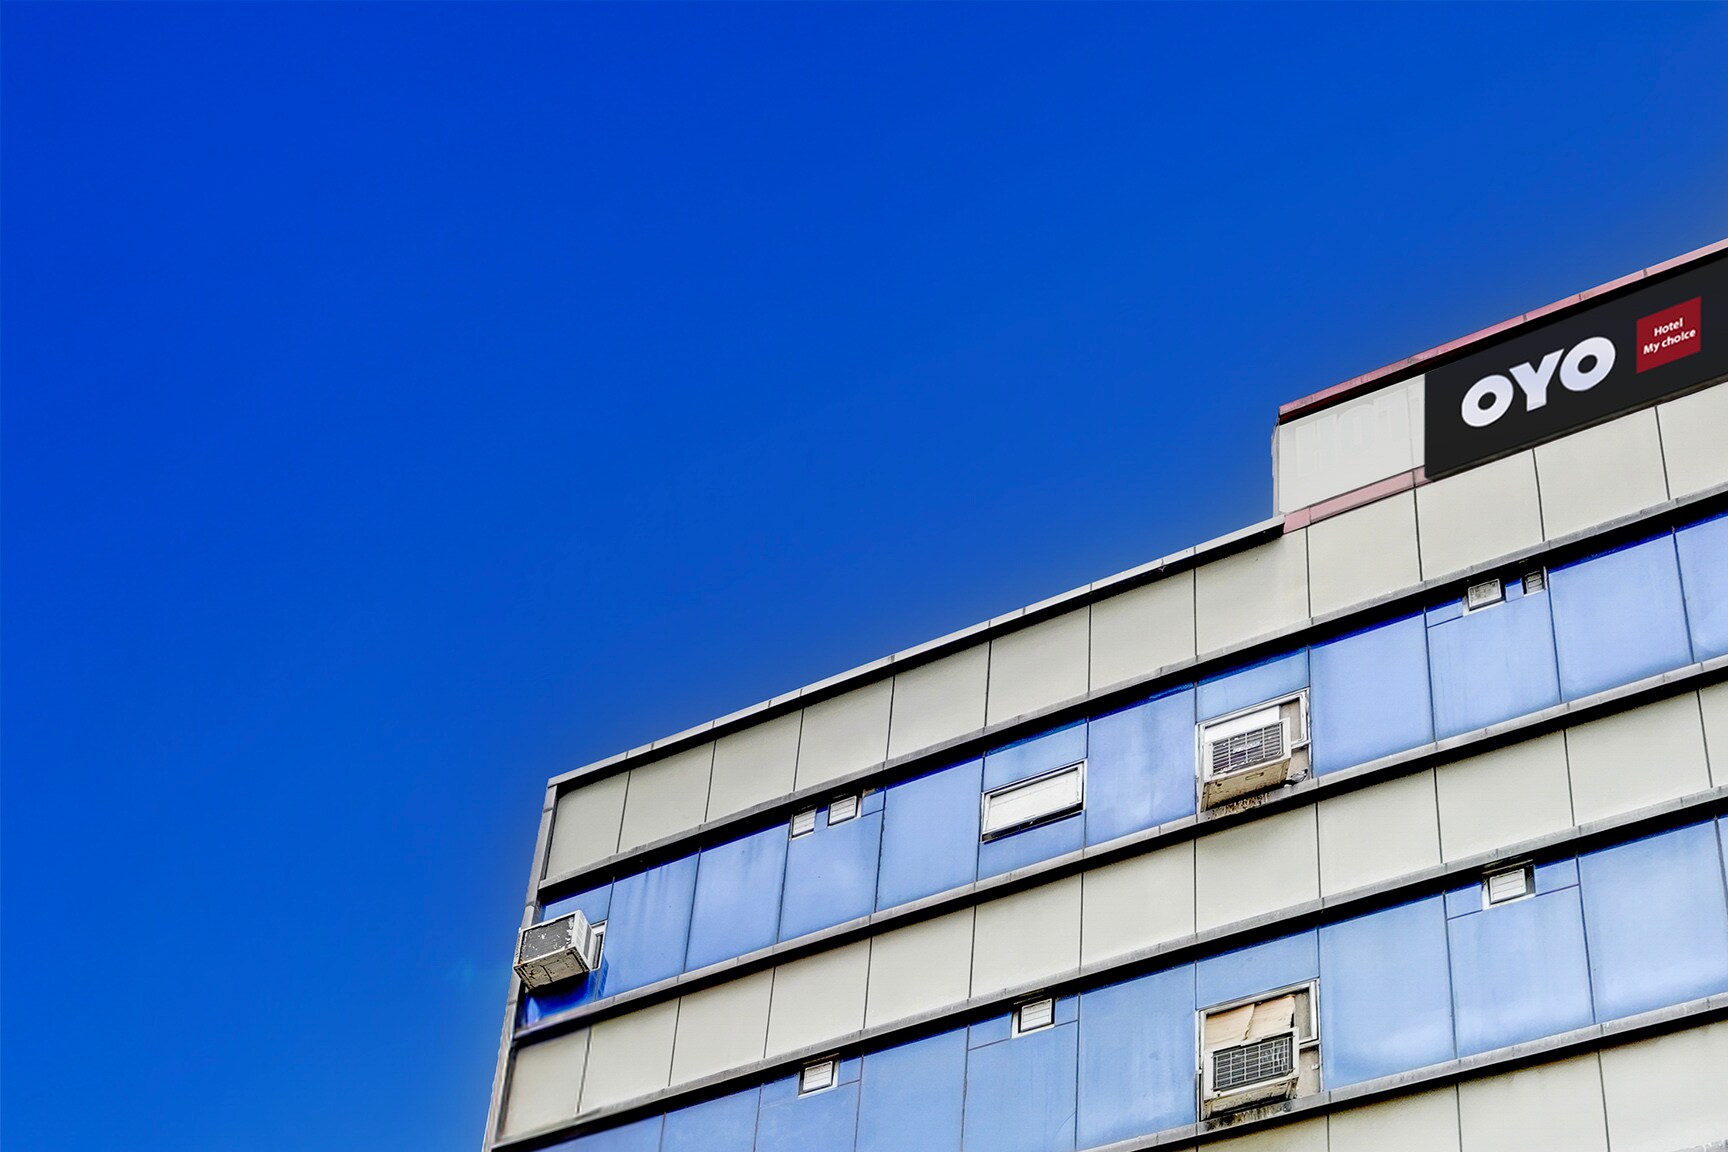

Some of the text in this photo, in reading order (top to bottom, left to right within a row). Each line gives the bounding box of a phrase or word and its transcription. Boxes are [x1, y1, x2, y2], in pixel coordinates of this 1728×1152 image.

[1653, 317, 1683, 337] Hotel
[1643, 329, 1696, 355] My choice
[1461, 336, 1616, 428] OYO
